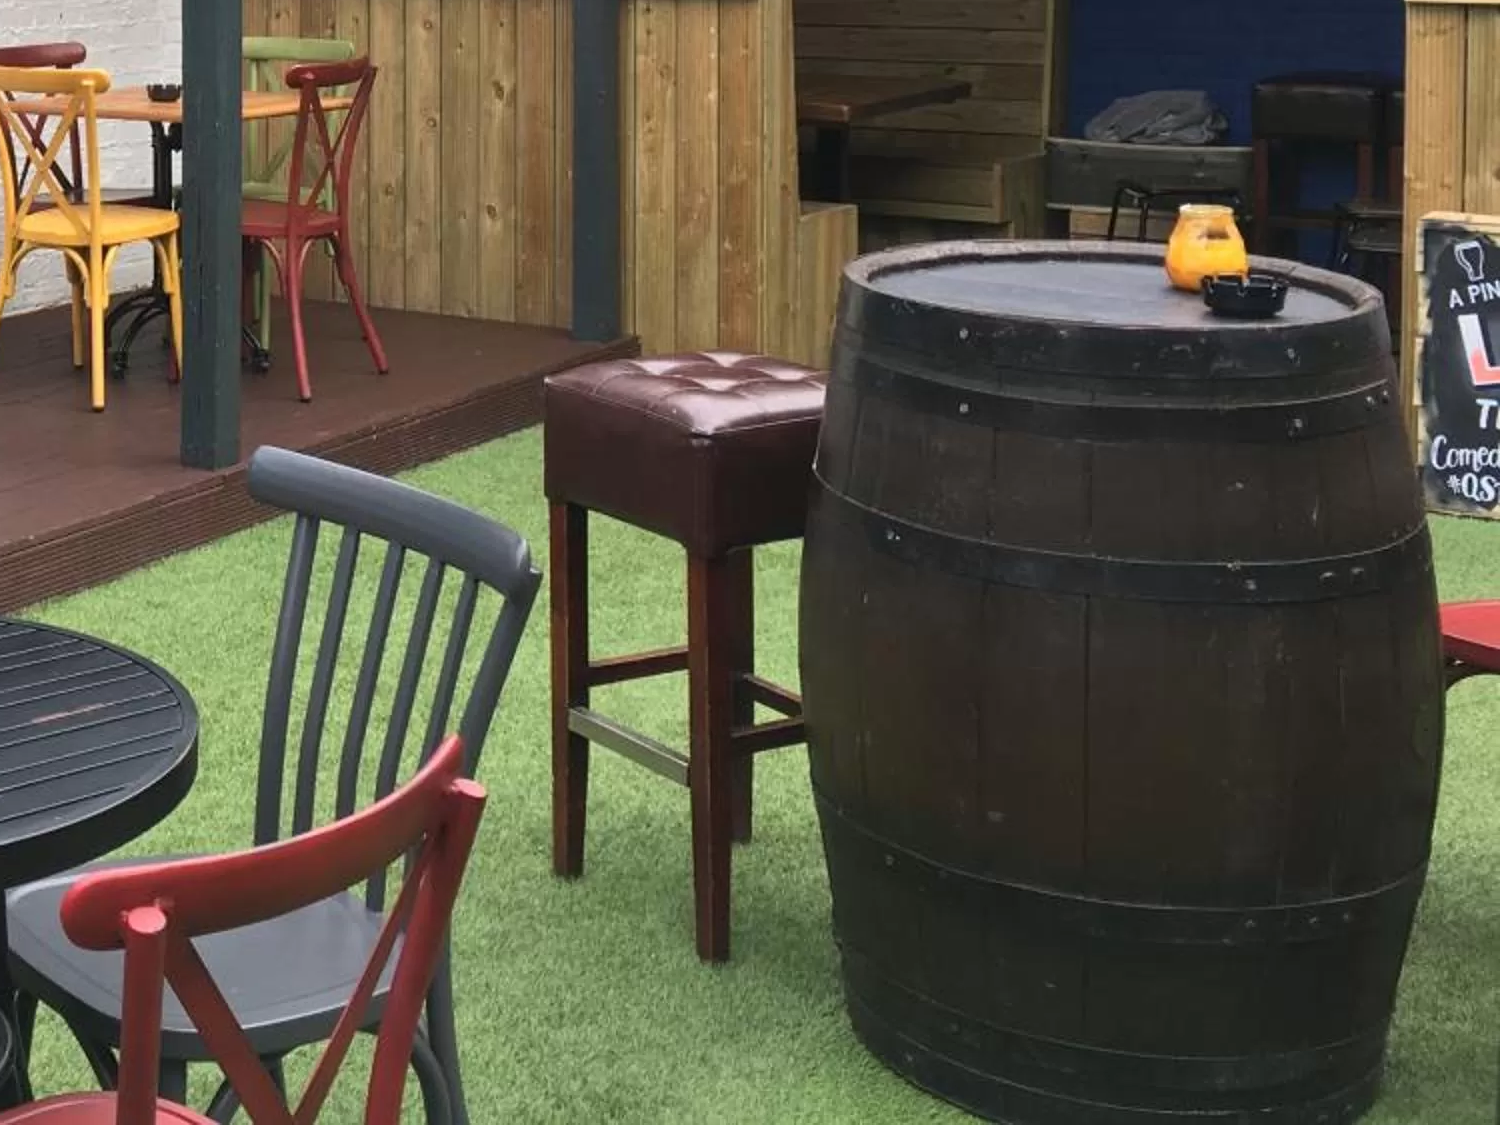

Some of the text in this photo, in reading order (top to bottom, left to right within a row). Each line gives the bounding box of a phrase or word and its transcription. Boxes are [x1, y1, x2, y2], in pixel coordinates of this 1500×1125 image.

[1449, 279, 1500, 309] A PIN
[1446, 472, 1500, 503] #QS
